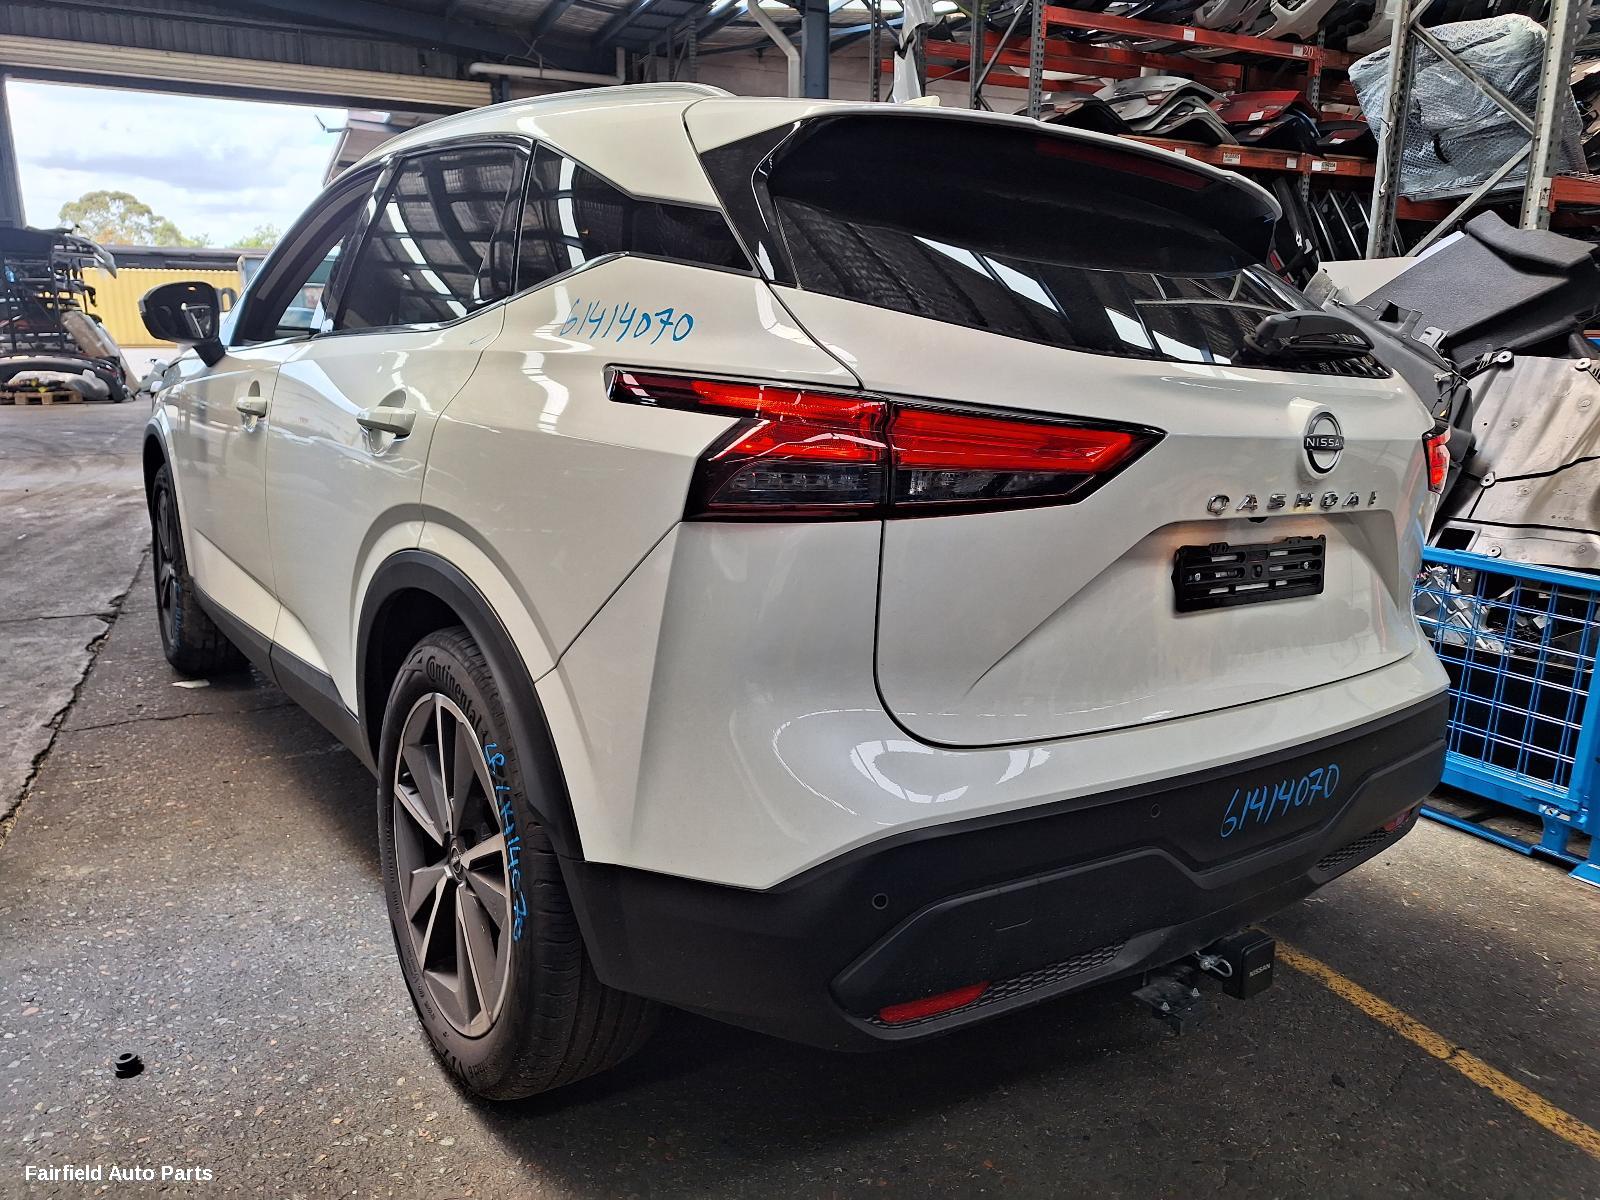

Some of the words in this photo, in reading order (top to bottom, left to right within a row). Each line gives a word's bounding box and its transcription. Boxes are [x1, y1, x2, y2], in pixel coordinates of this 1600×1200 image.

[559, 298, 694, 345] 61414070
[1207, 491, 1378, 515] QASHQAI
[426, 655, 482, 731] Continental
[1220, 763, 1341, 838] 61414070
